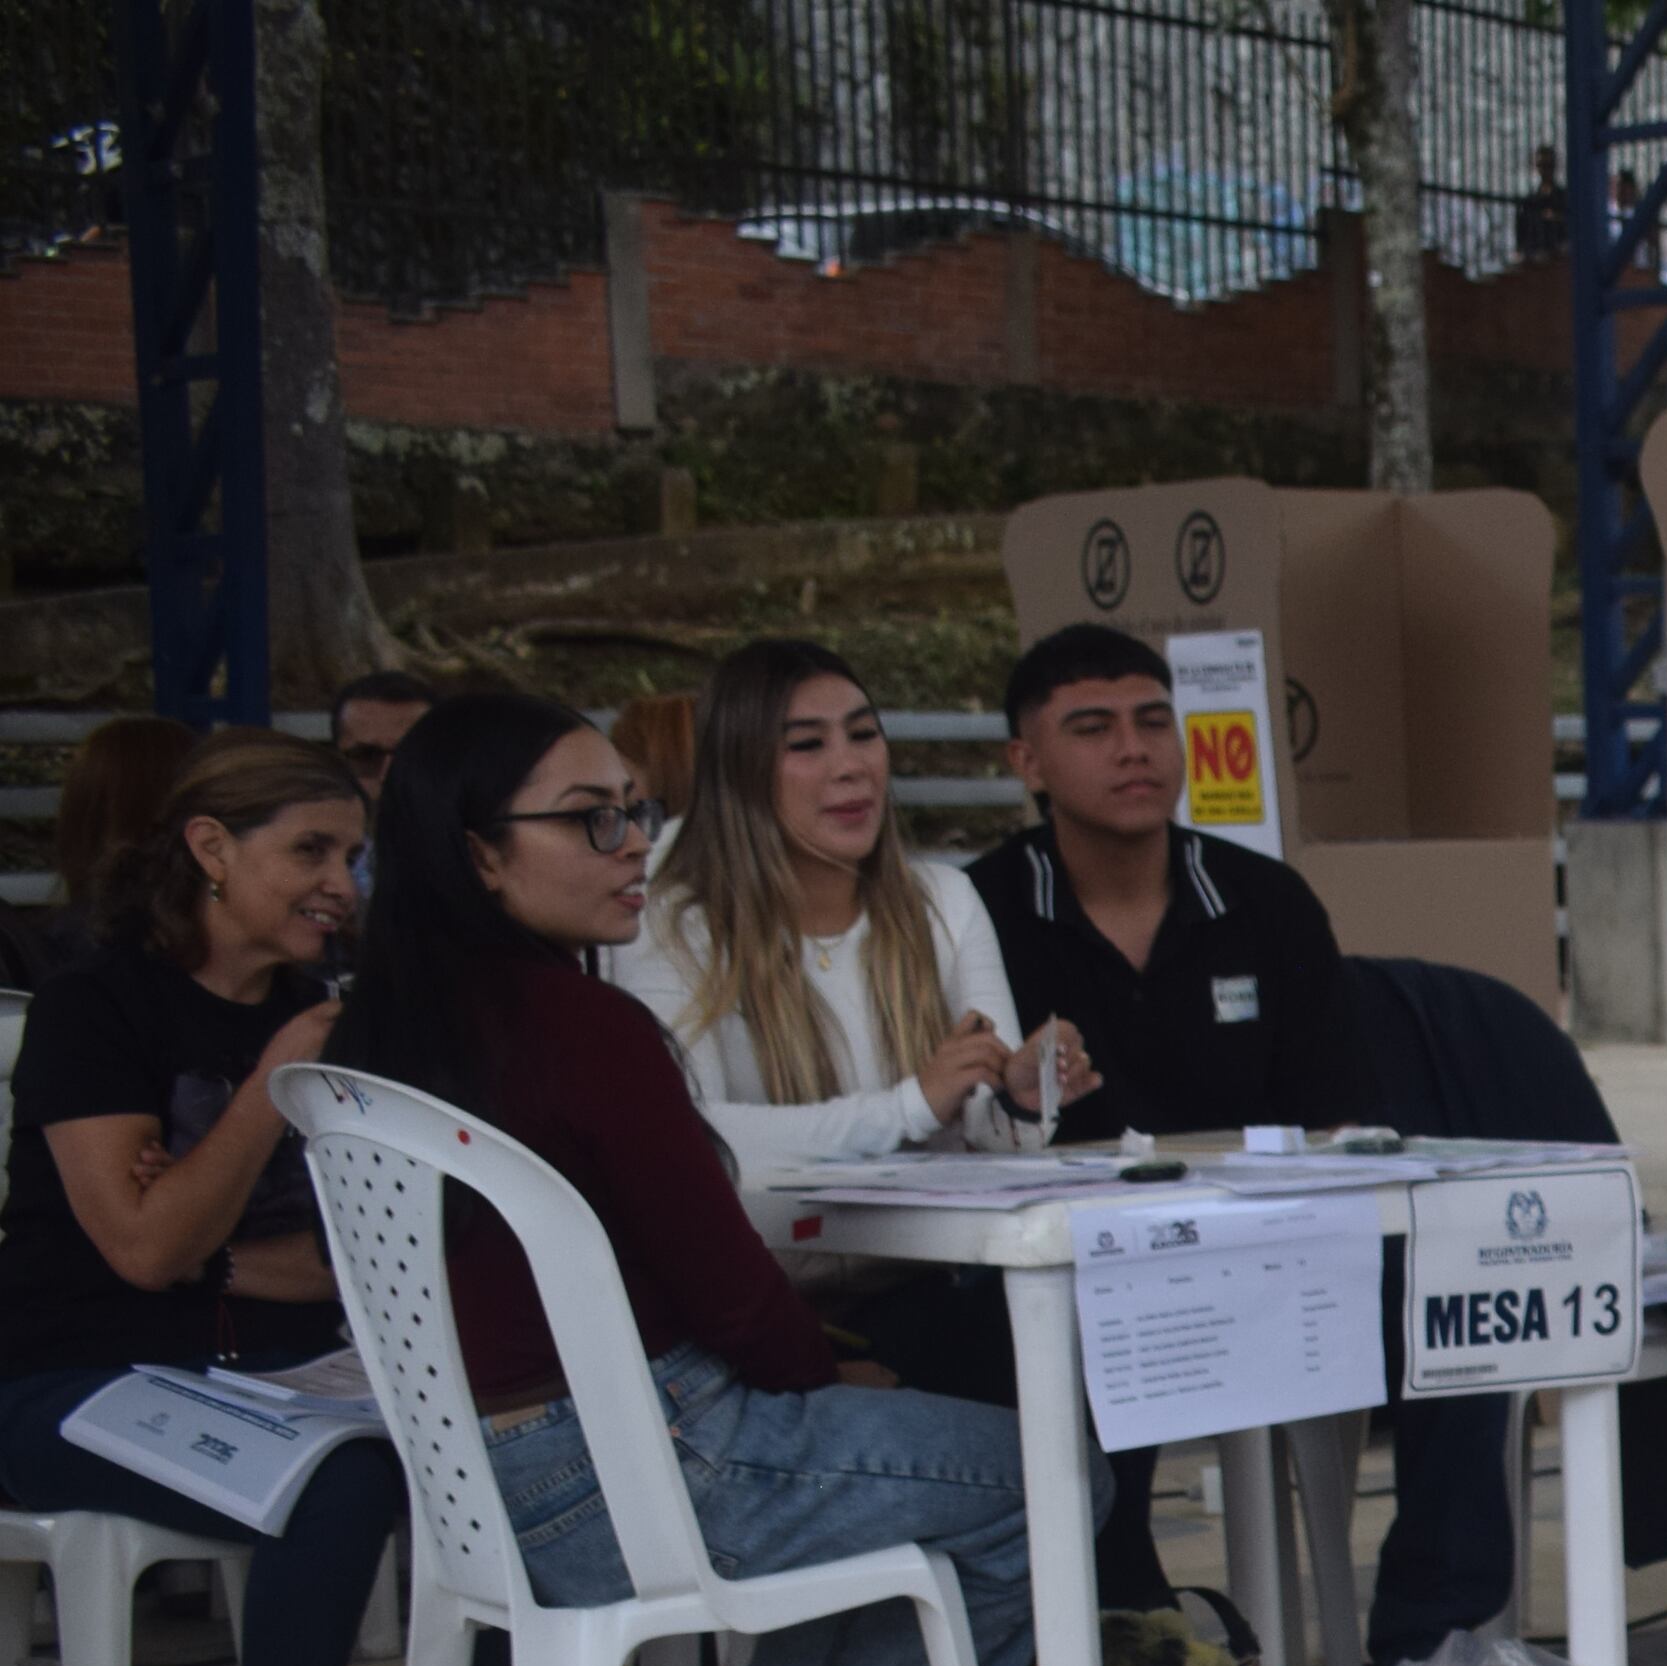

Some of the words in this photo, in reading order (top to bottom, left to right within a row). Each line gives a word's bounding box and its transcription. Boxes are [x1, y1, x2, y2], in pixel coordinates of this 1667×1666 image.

[1191, 724, 1256, 783] NO
[1425, 1288, 1549, 1349] MESA
[1563, 1283, 1621, 1337] 13
